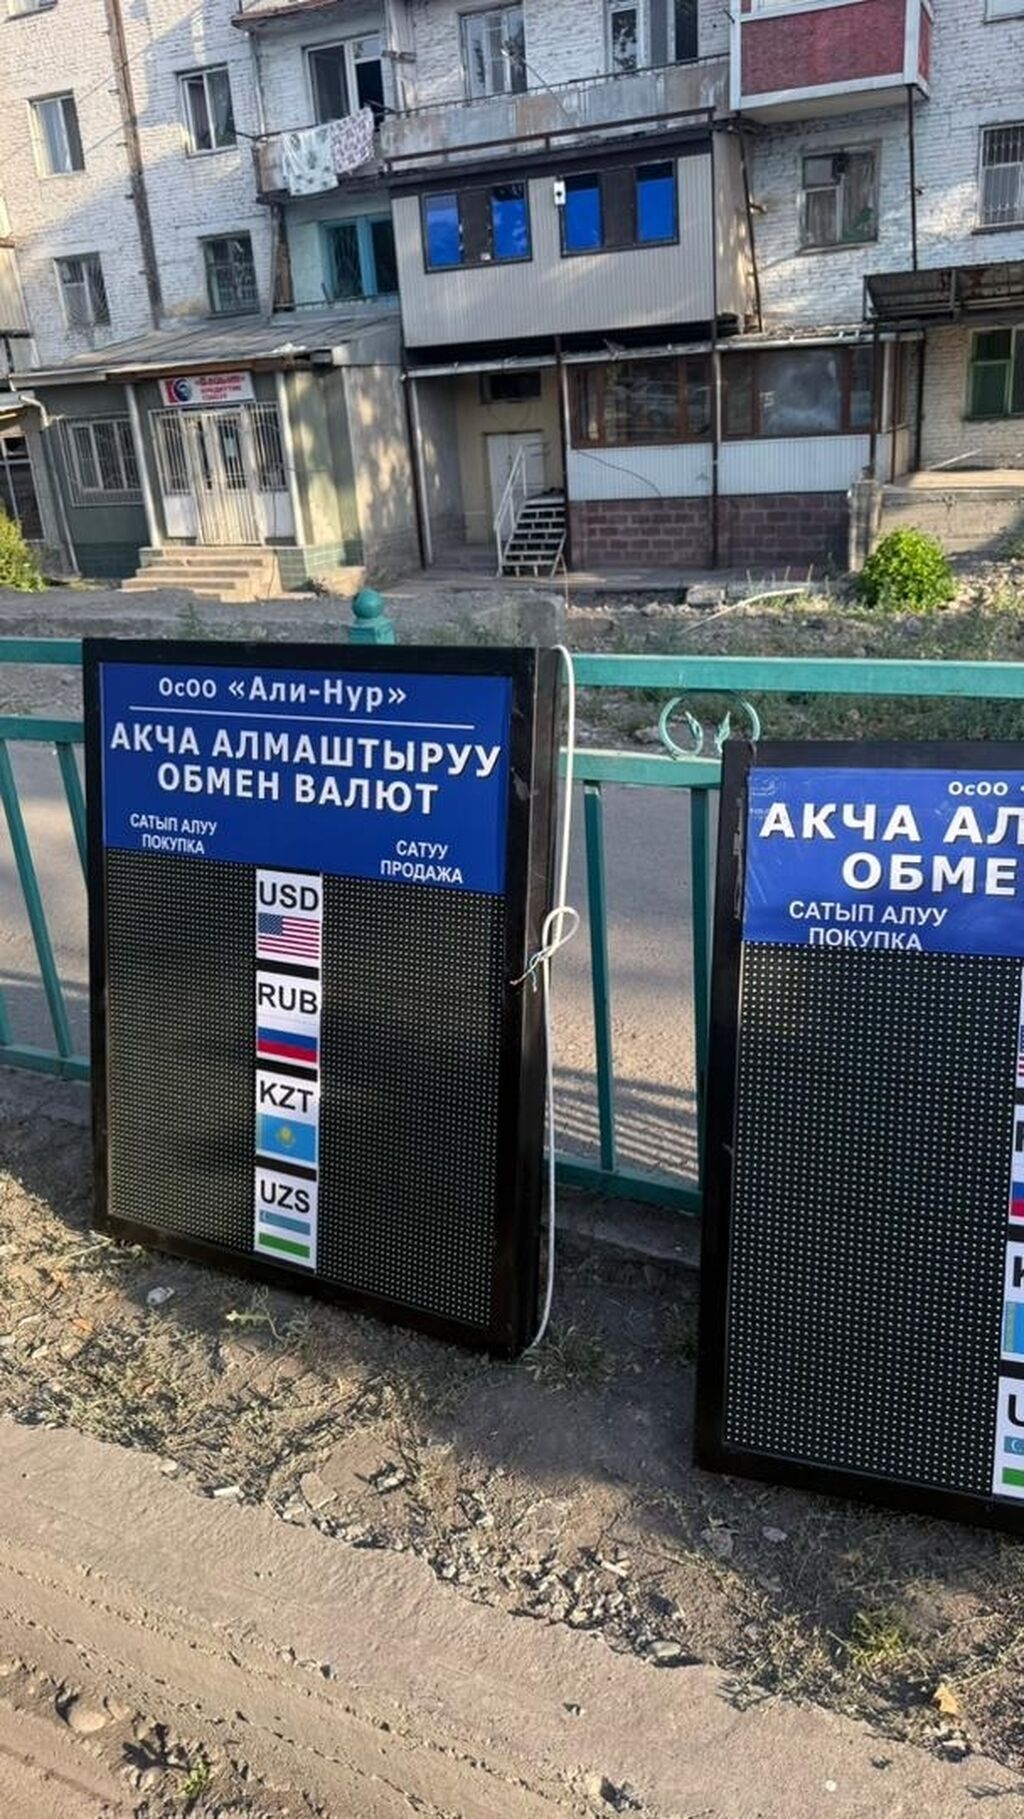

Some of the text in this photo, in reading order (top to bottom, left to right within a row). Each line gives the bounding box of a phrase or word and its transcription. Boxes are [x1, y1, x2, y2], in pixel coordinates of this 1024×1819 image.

[159, 676, 406, 712] ОсОО «Али-Нур»
[110, 722, 501, 777] АКЧА АЛМАШТЫРУУ
[157, 762, 438, 814] ОБМЕН ВАЛЮТ
[948, 781, 1009, 796] ОсОО
[130, 813, 218, 836] САТЫП АЛУУ
[759, 802, 921, 842] АКЧА
[142, 833, 205, 854] ПОКУПКА
[396, 840, 449, 860] САТУУ
[381, 860, 463, 884] ПРОДАЖА
[842, 852, 1018, 896] ОБМЕ
[258, 881, 319, 911] USD
[789, 901, 948, 926] САТЫП АЛУУ
[809, 927, 923, 950] ПОКУПКА
[258, 982, 318, 1015] RUB
[260, 1080, 314, 1113] KZT
[260, 1180, 311, 1214] UZS
